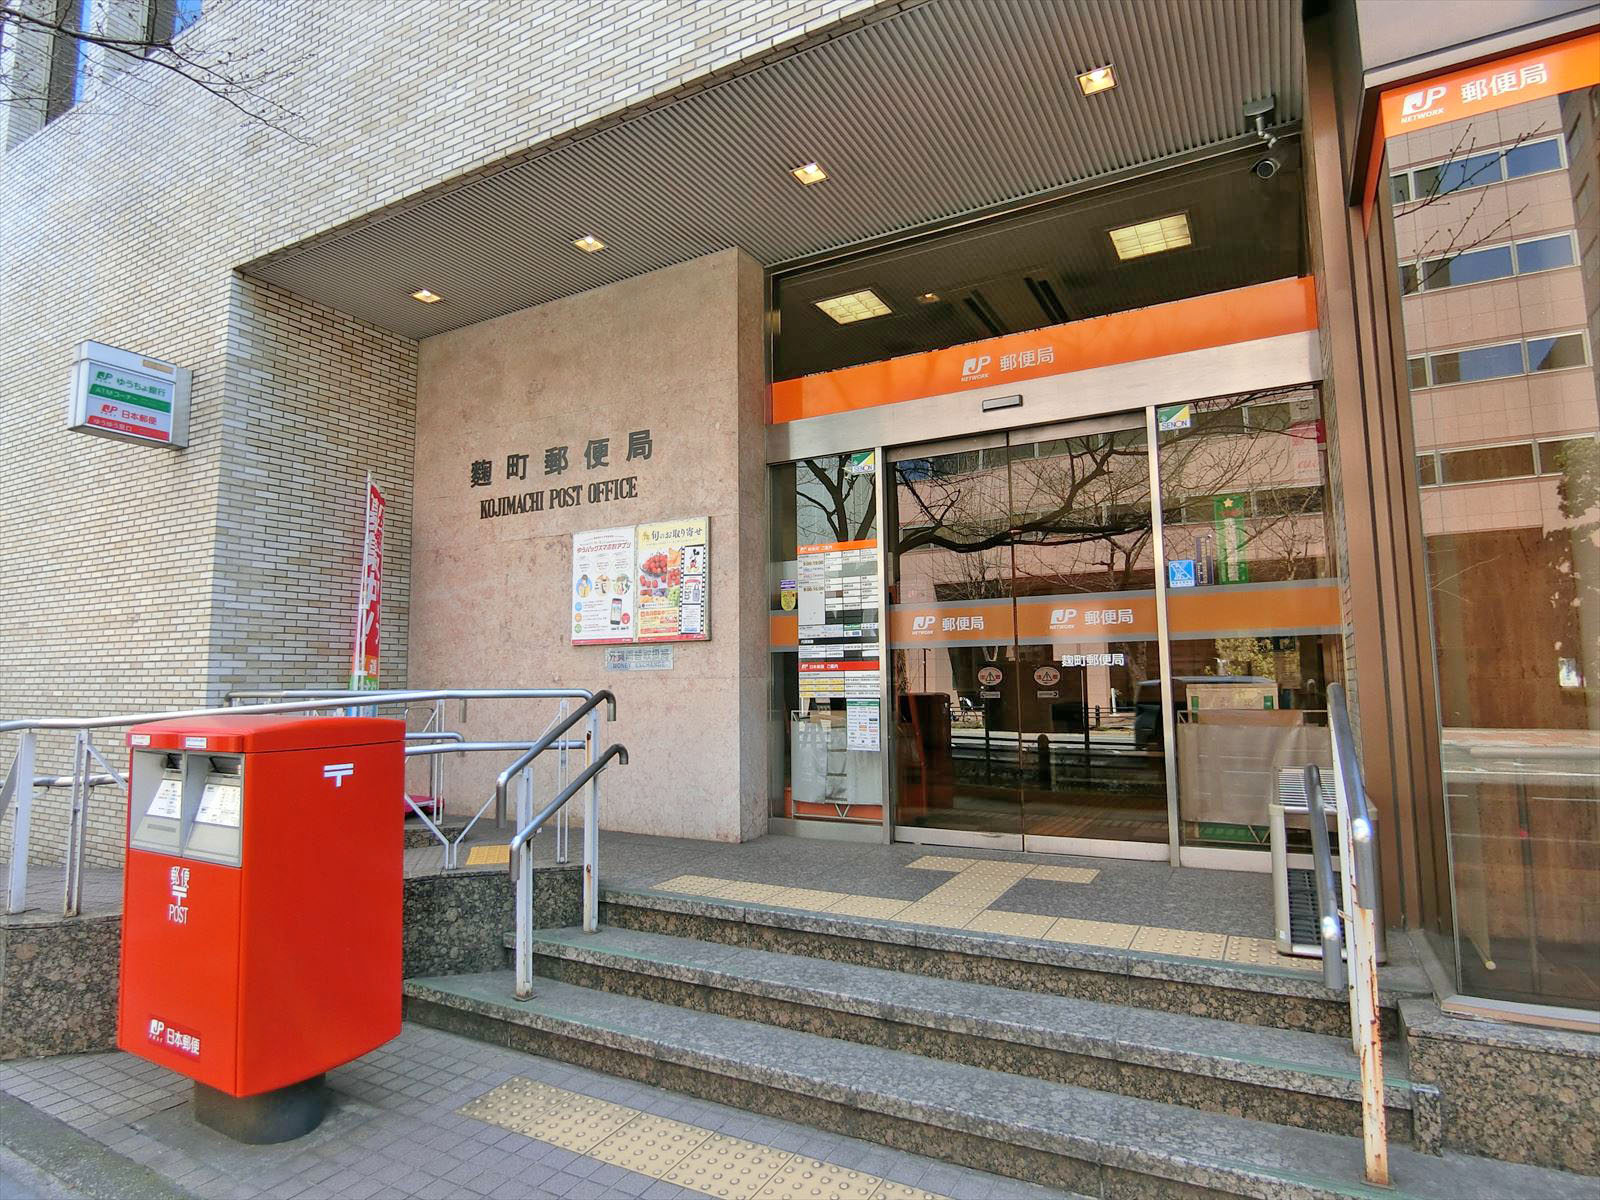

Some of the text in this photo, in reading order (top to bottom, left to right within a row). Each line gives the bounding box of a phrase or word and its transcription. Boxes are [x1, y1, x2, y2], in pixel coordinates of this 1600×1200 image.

[1460, 63, 1548, 104] 郵便局
[1400, 107, 1445, 123] NETWORK
[1000, 346, 1055, 372] 郵便局
[960, 373, 990, 382] NETWORK
[116, 377, 166, 397] ゆうちょ銀行
[121, 409, 158, 425] 日本郵便
[1161, 420, 1193, 430] SENON
[480, 475, 638, 519] KOJIMACHI POST OFFICE
[651, 527, 703, 542] 旬のお取り寄せ
[942, 615, 985, 632] 郵便局
[1084, 608, 1134, 625] 郵便局
[170, 866, 190, 888] 郵便
[169, 903, 189, 924] POST
[166, 1027, 200, 1055] 日本郵便
